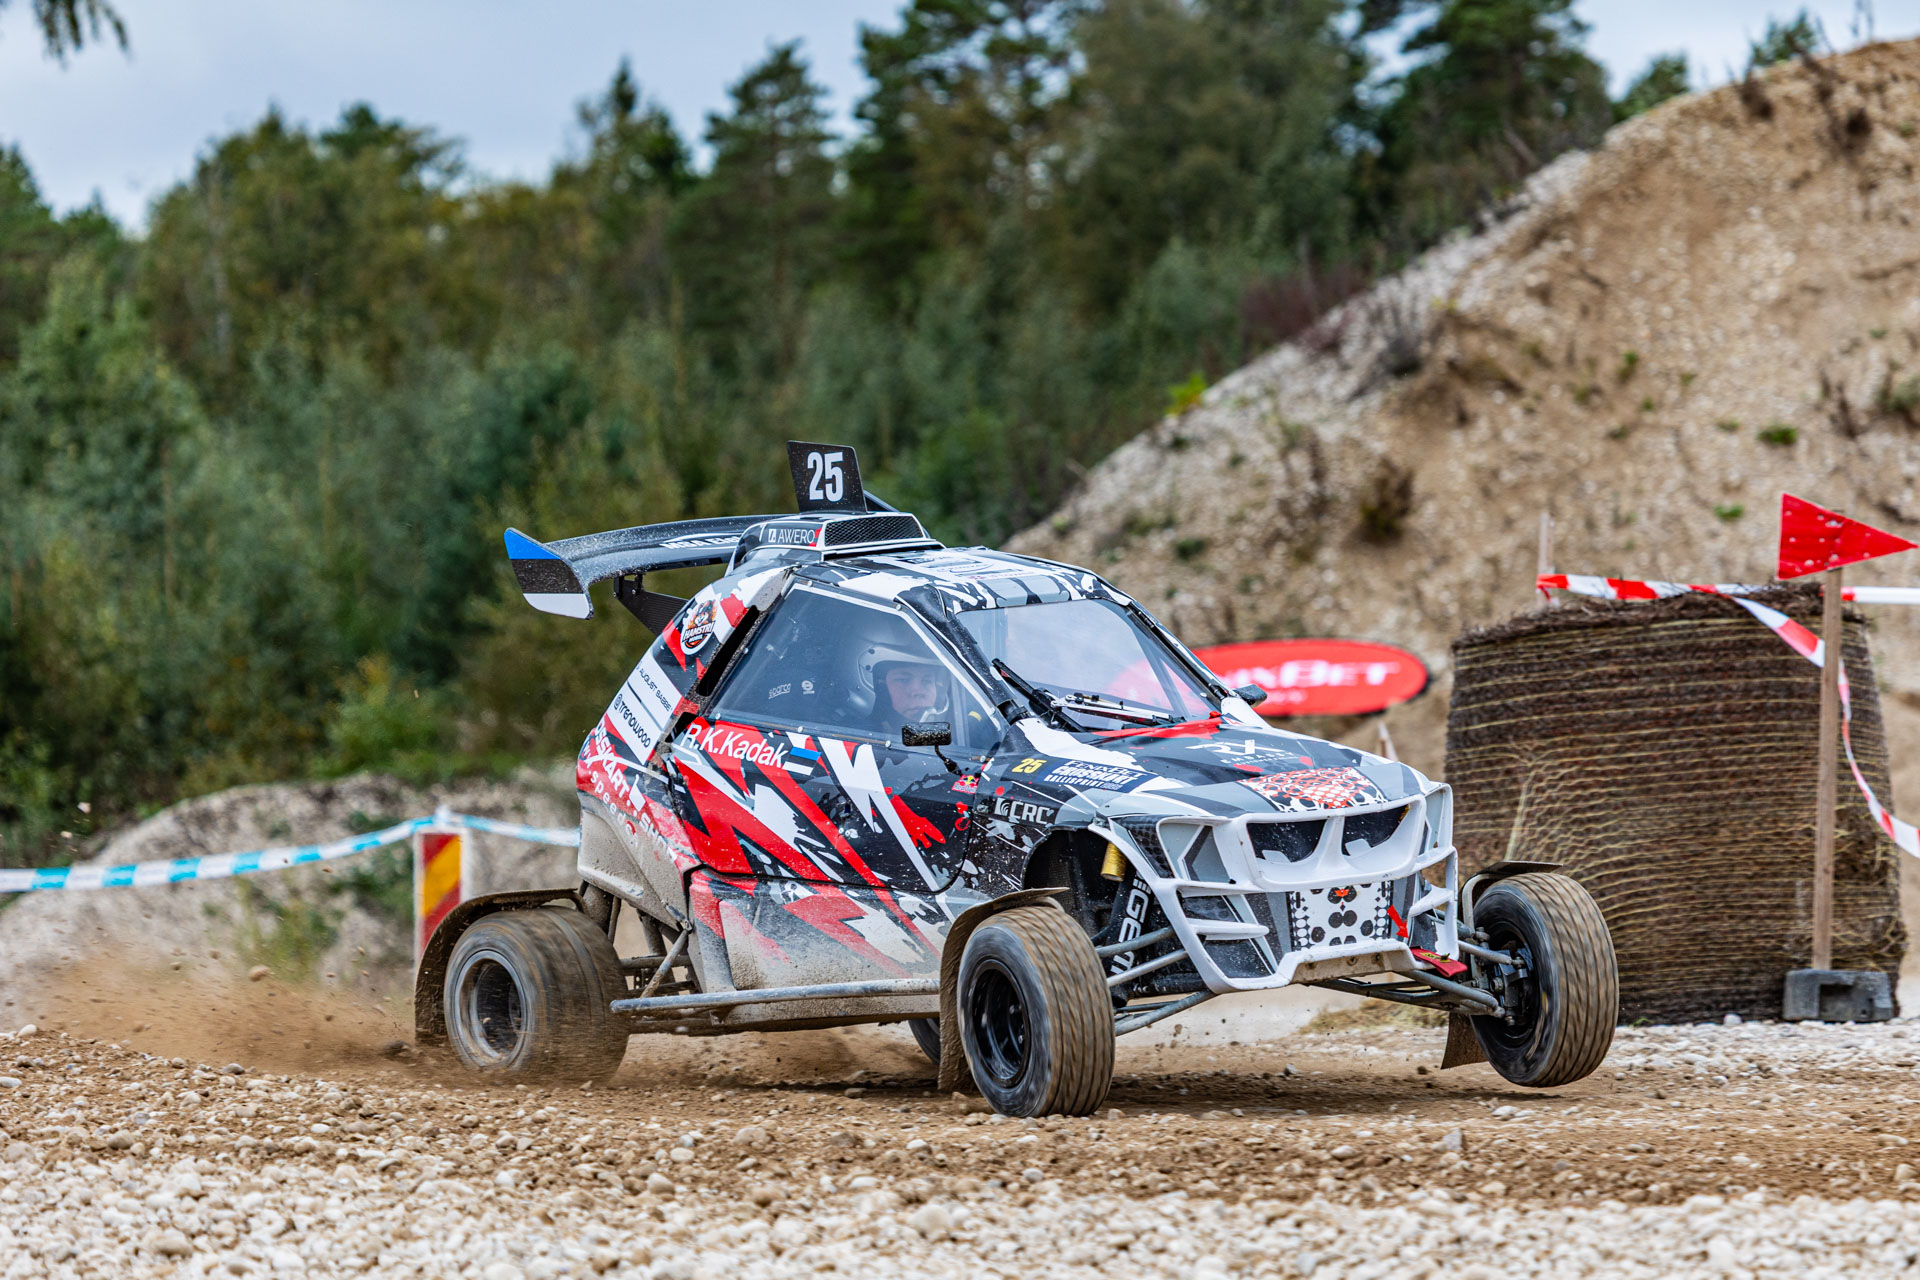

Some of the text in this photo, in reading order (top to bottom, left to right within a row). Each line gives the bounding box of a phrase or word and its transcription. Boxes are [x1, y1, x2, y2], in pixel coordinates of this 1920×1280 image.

[807, 452, 843, 502] 25
[777, 529, 815, 544] AWERO
[680, 723, 789, 769] R.K.Kadak
[1011, 758, 1047, 774] 25
[1051, 765, 1139, 785] CROSSKART
[1043, 774, 1105, 788] RALLISPRINT
[1009, 800, 1051, 825] CRC
